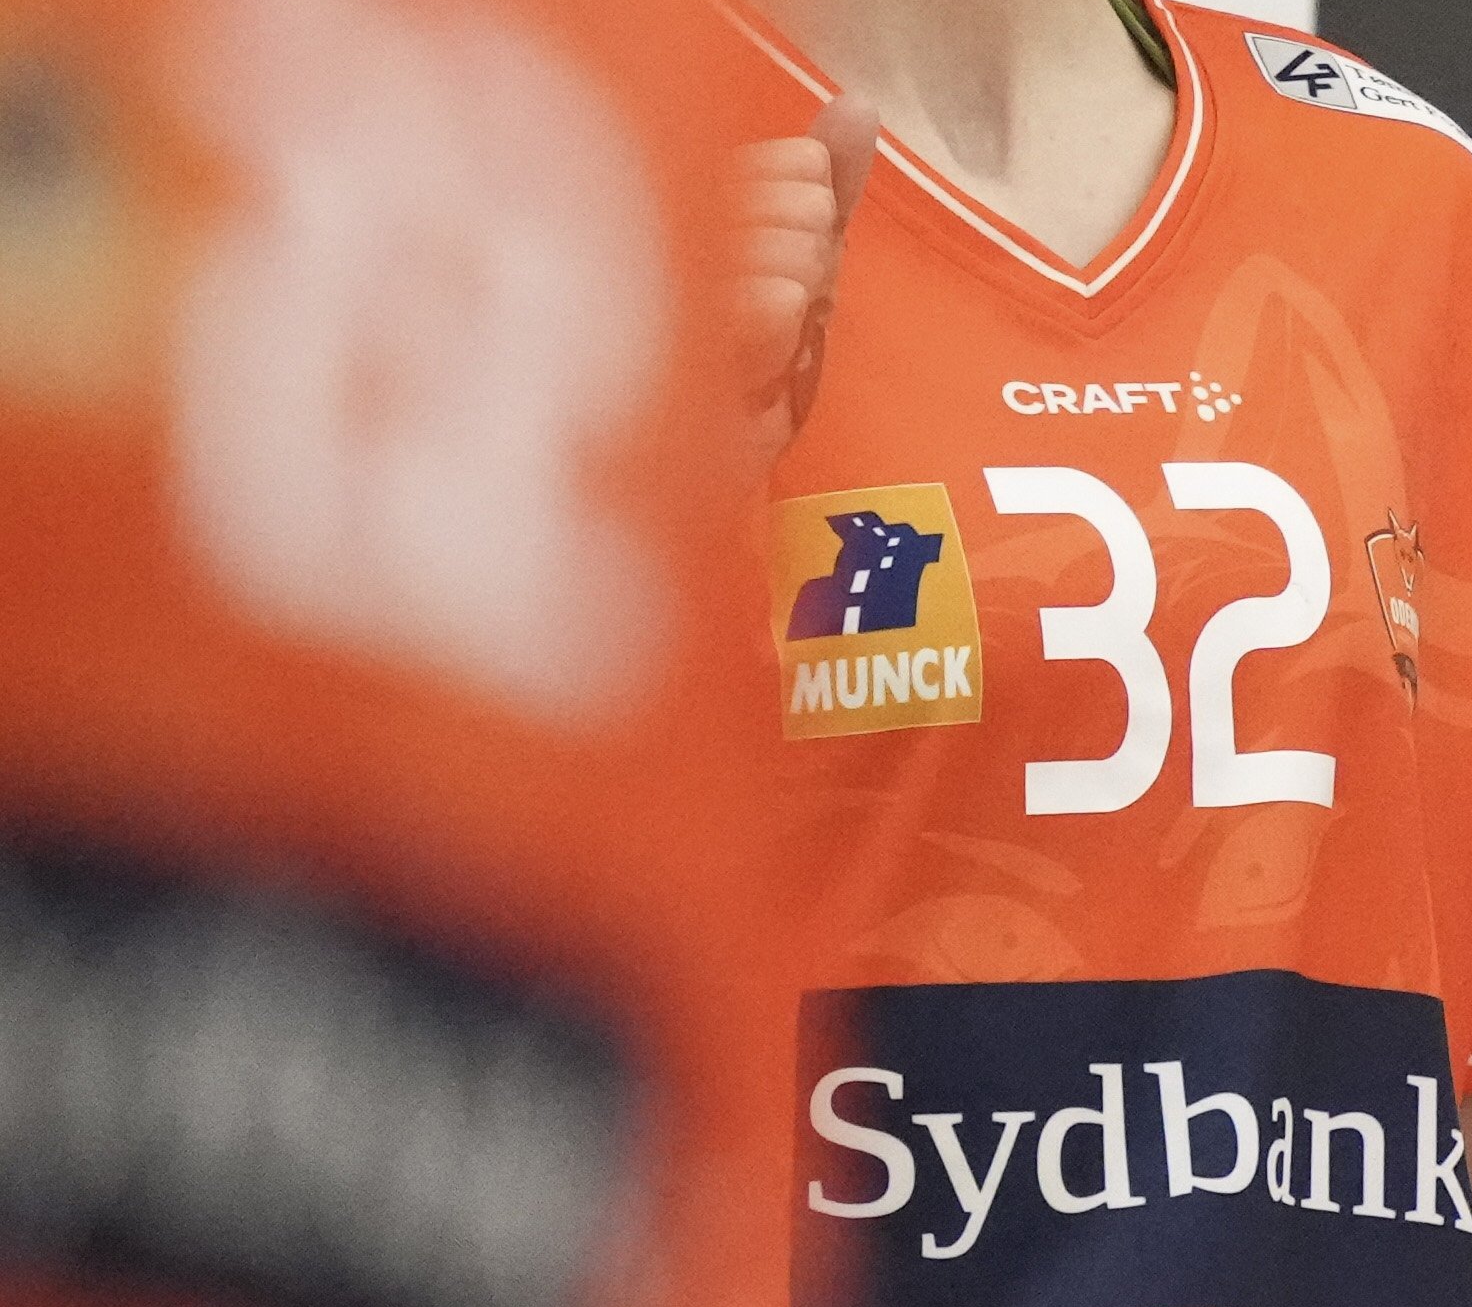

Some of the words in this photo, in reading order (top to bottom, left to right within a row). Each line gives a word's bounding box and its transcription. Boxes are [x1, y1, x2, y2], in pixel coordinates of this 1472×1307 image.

[1001, 380, 1182, 415] CRAFT
[983, 461, 1338, 816] 32
[789, 643, 974, 715] MUNCK
